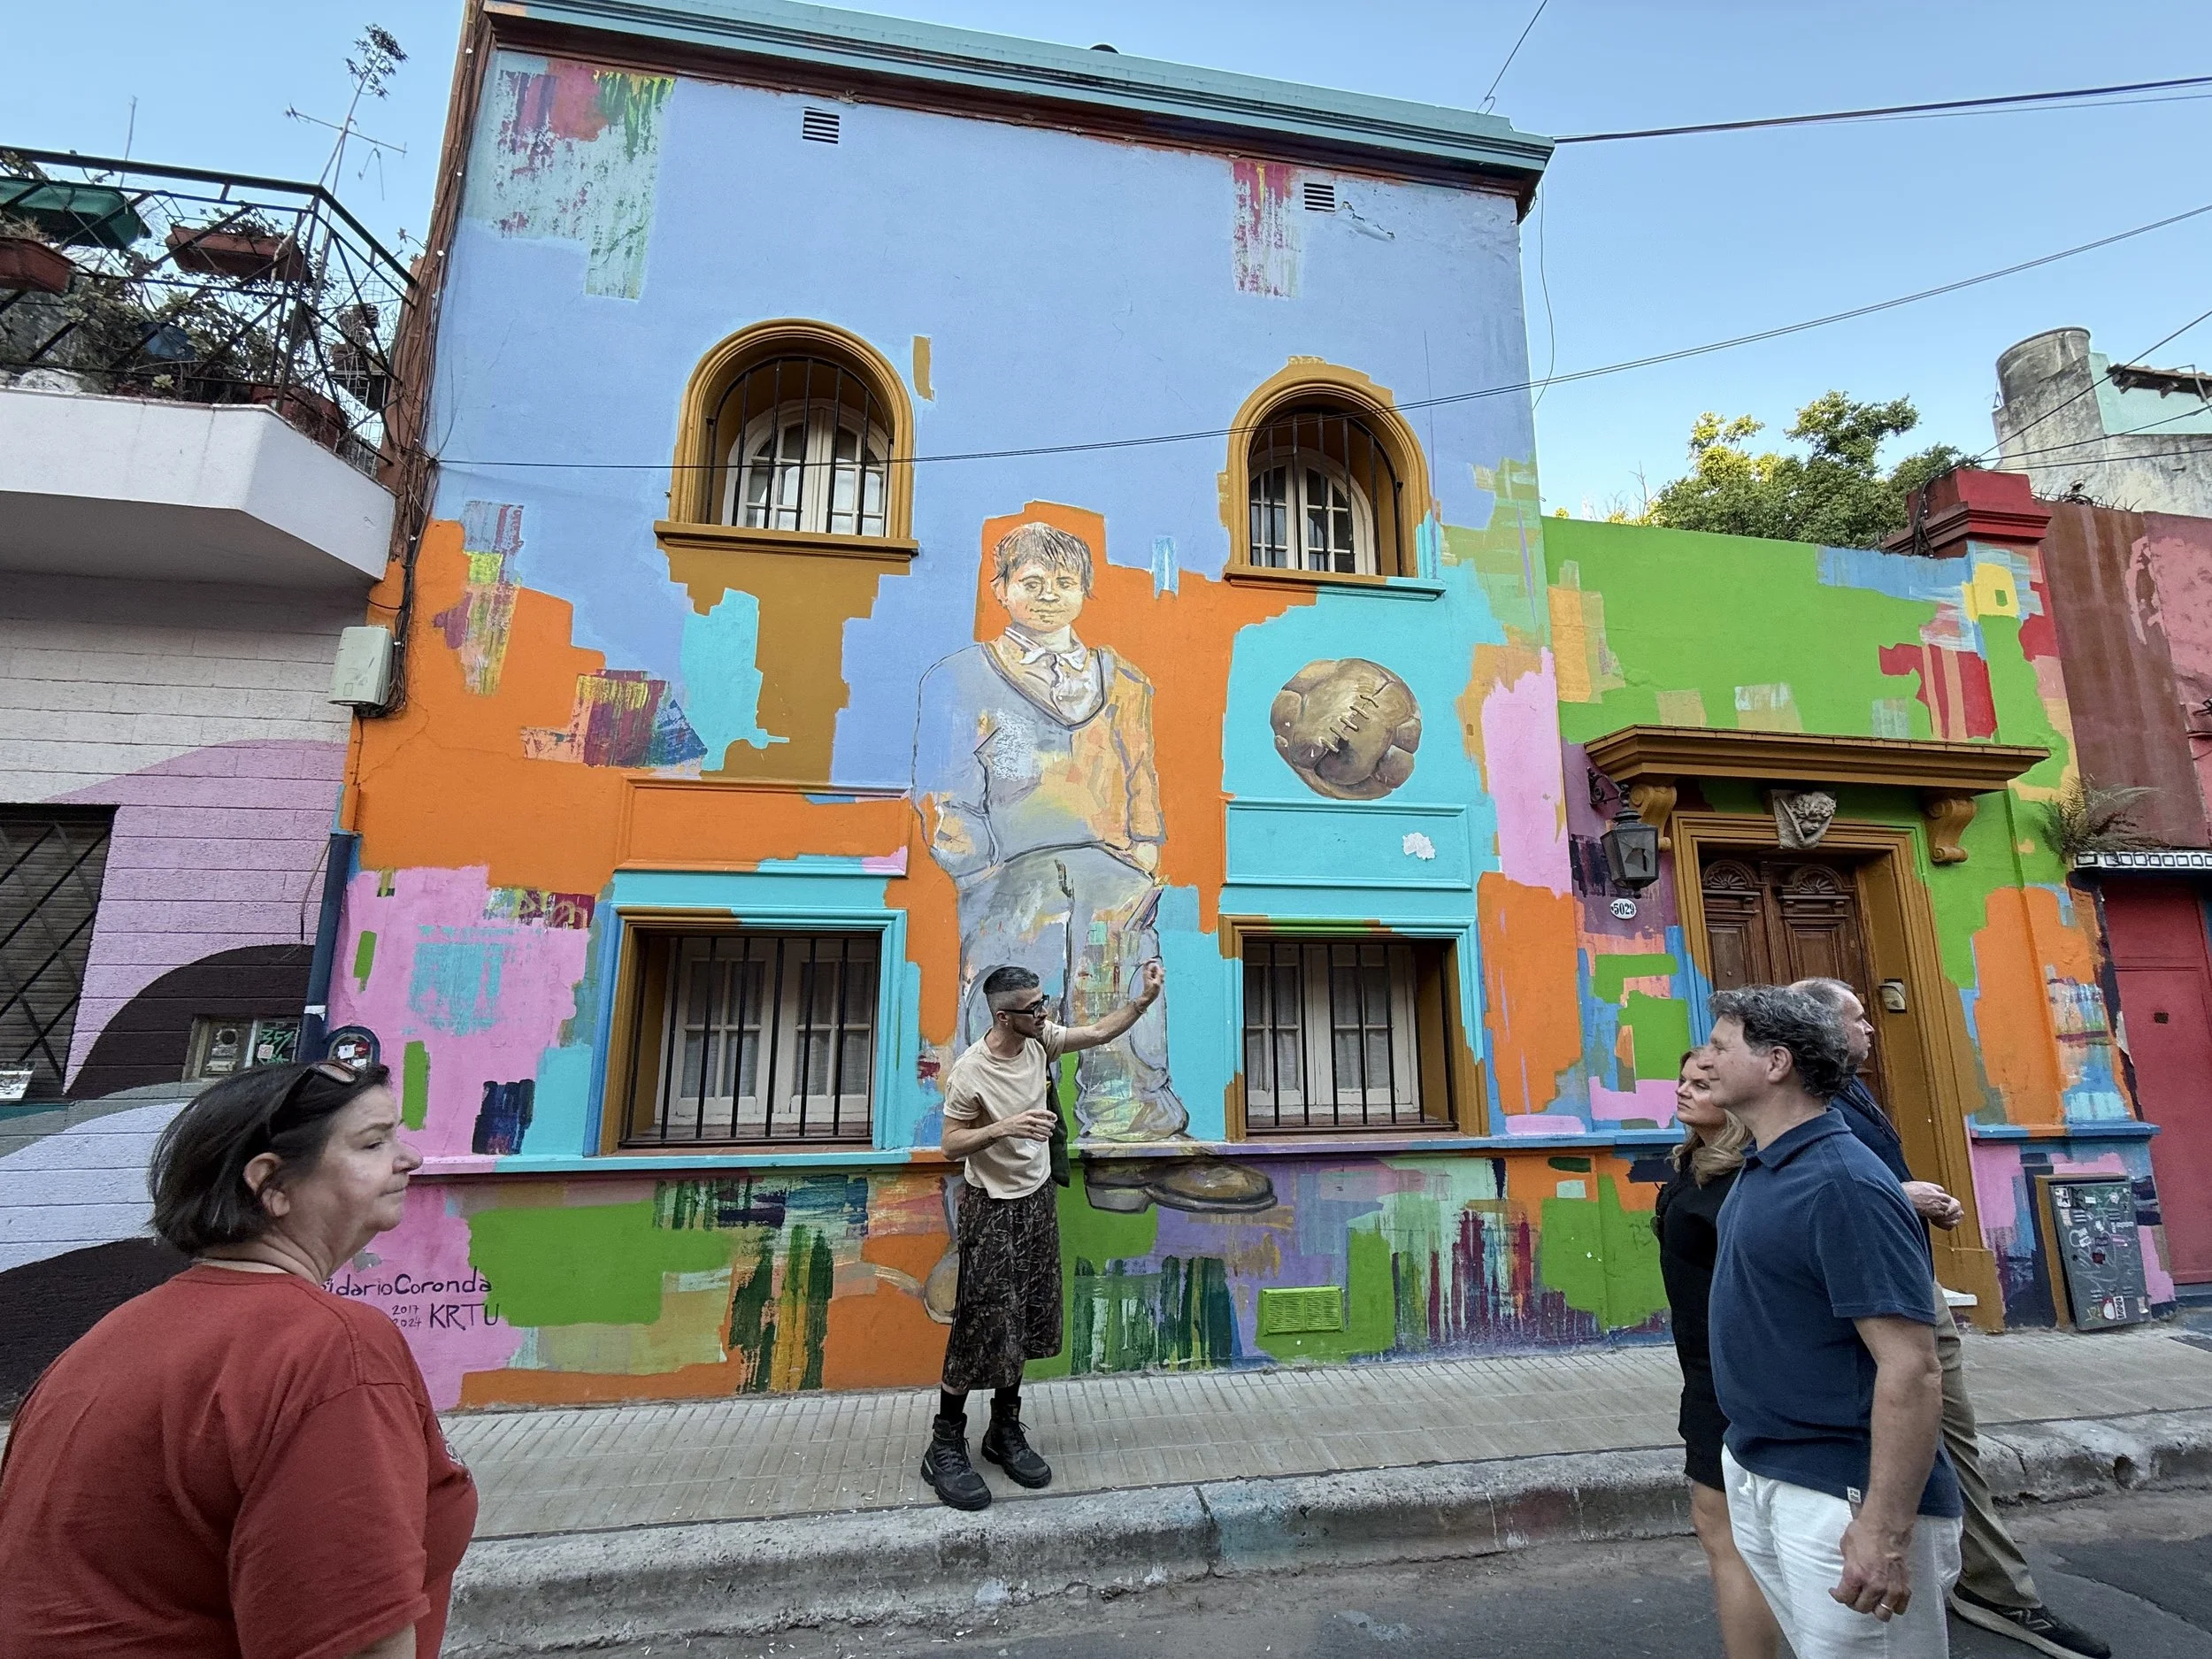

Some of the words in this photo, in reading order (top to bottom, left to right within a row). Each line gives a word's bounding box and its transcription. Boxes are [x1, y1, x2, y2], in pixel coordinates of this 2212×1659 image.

[1613, 902, 1635, 915] 5029
[392, 1305, 419, 1316] 2017
[430, 1302, 500, 1331] KRTU
